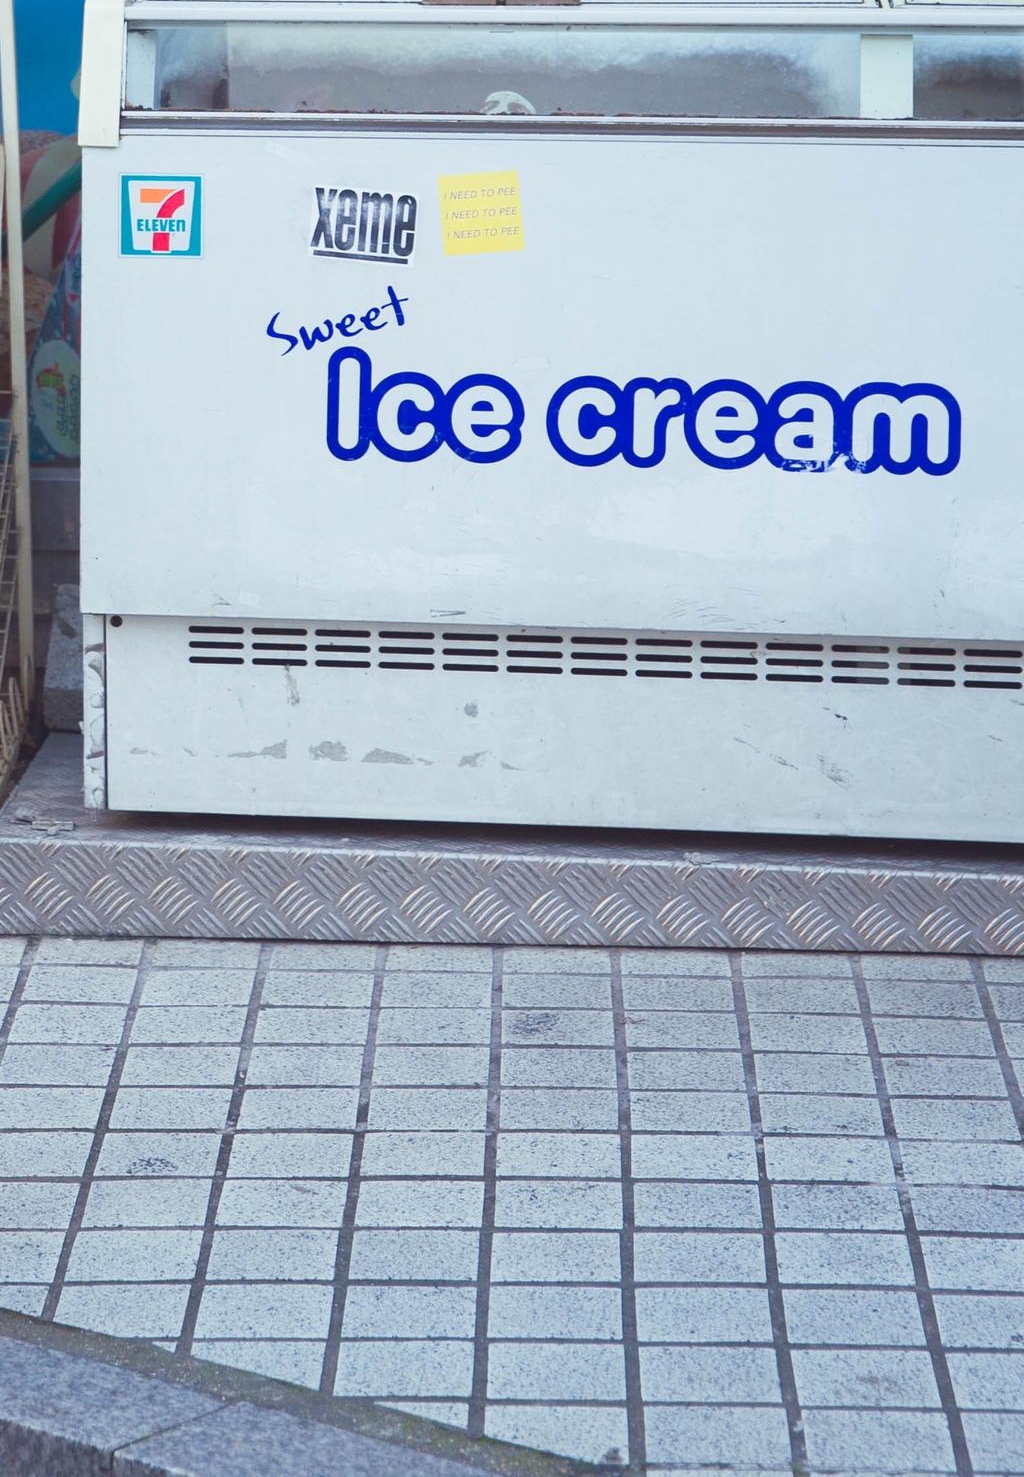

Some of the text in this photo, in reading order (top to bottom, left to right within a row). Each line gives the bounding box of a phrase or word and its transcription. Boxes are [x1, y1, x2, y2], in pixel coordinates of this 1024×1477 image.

[449, 189, 477, 200] NEED
[480, 187, 494, 198] TO
[497, 186, 517, 197] PEE
[451, 209, 478, 220] NEED
[482, 207, 496, 218] TO
[499, 206, 518, 217] PEE
[452, 229, 480, 240] NEED
[484, 227, 498, 238] TO
[501, 226, 520, 237] PEE
[265, 284, 410, 357] Sweet
[326, 345, 962, 475] Ice cream
